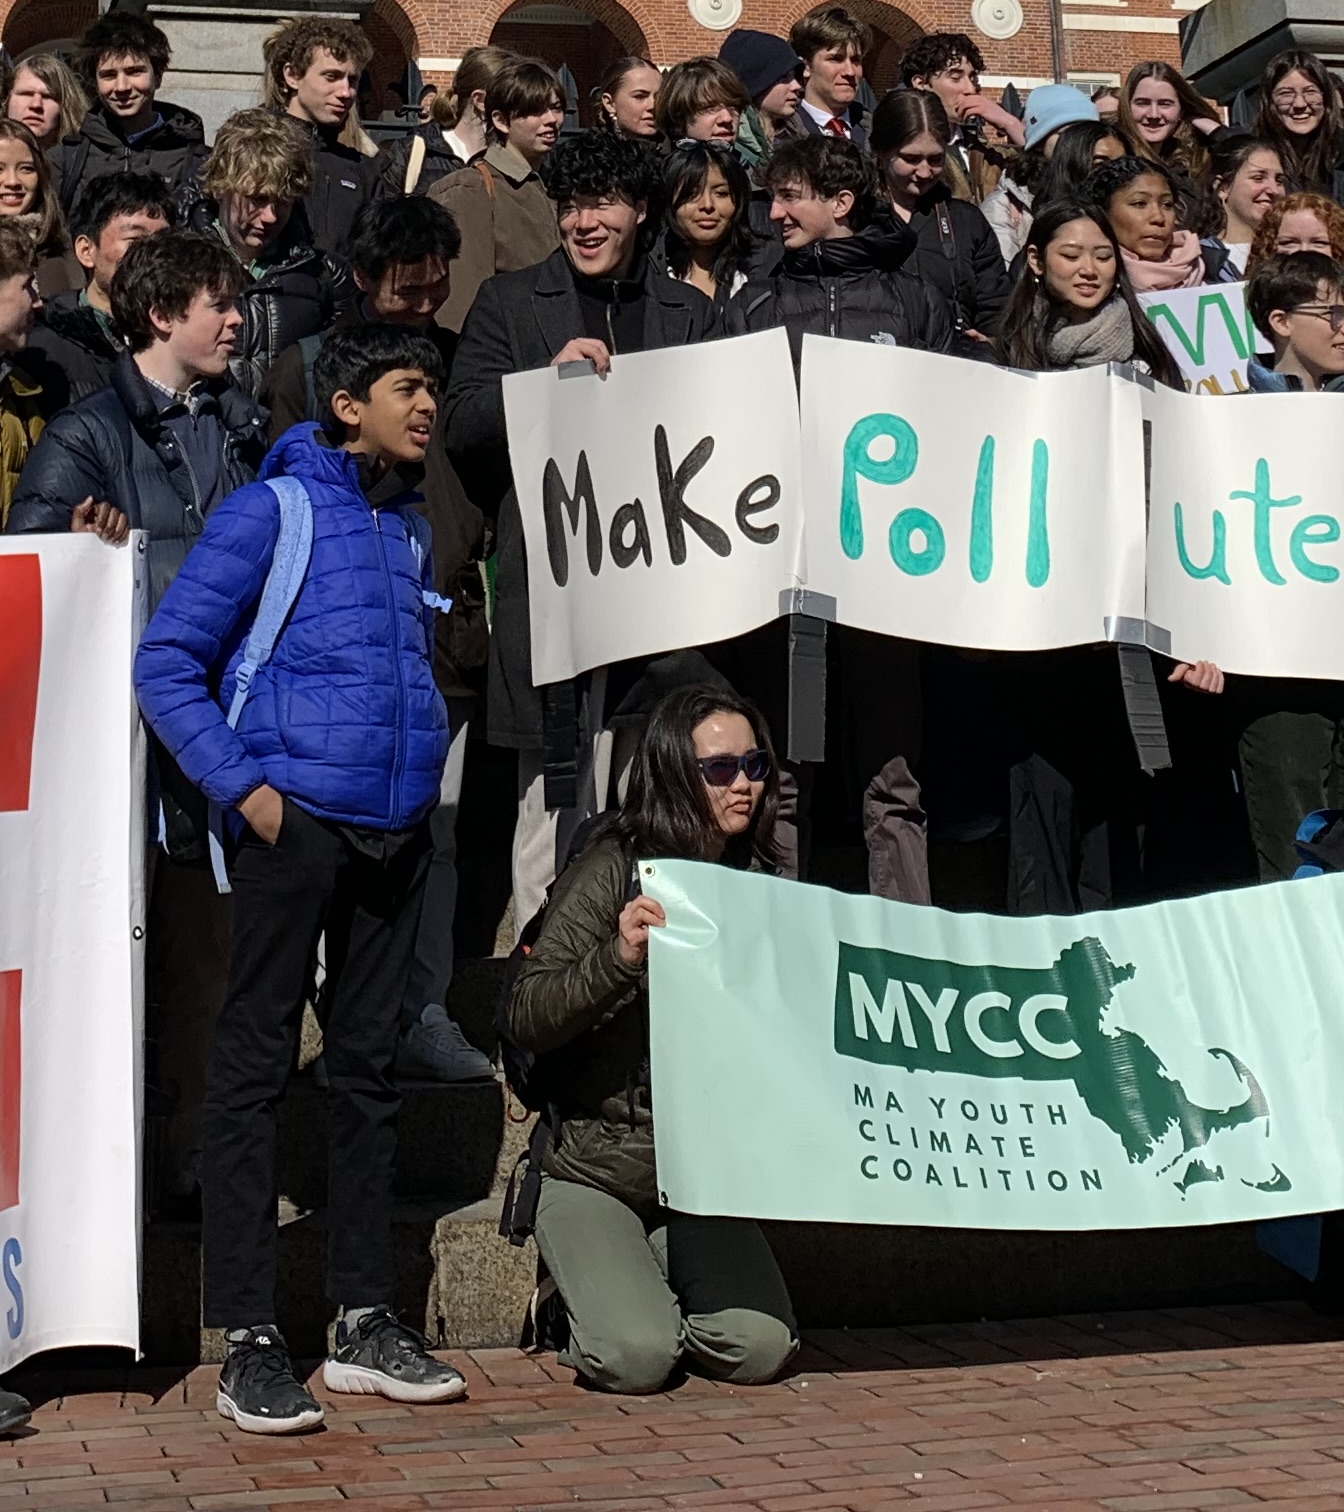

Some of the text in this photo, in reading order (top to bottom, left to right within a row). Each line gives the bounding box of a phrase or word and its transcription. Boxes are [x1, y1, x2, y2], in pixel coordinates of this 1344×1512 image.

[848, 970, 1083, 1060] MYCC
[853, 1082, 1068, 1126] MA YOUTH
[858, 1118, 1036, 1158] CLIMATE
[859, 1154, 1104, 1192] COALITION
